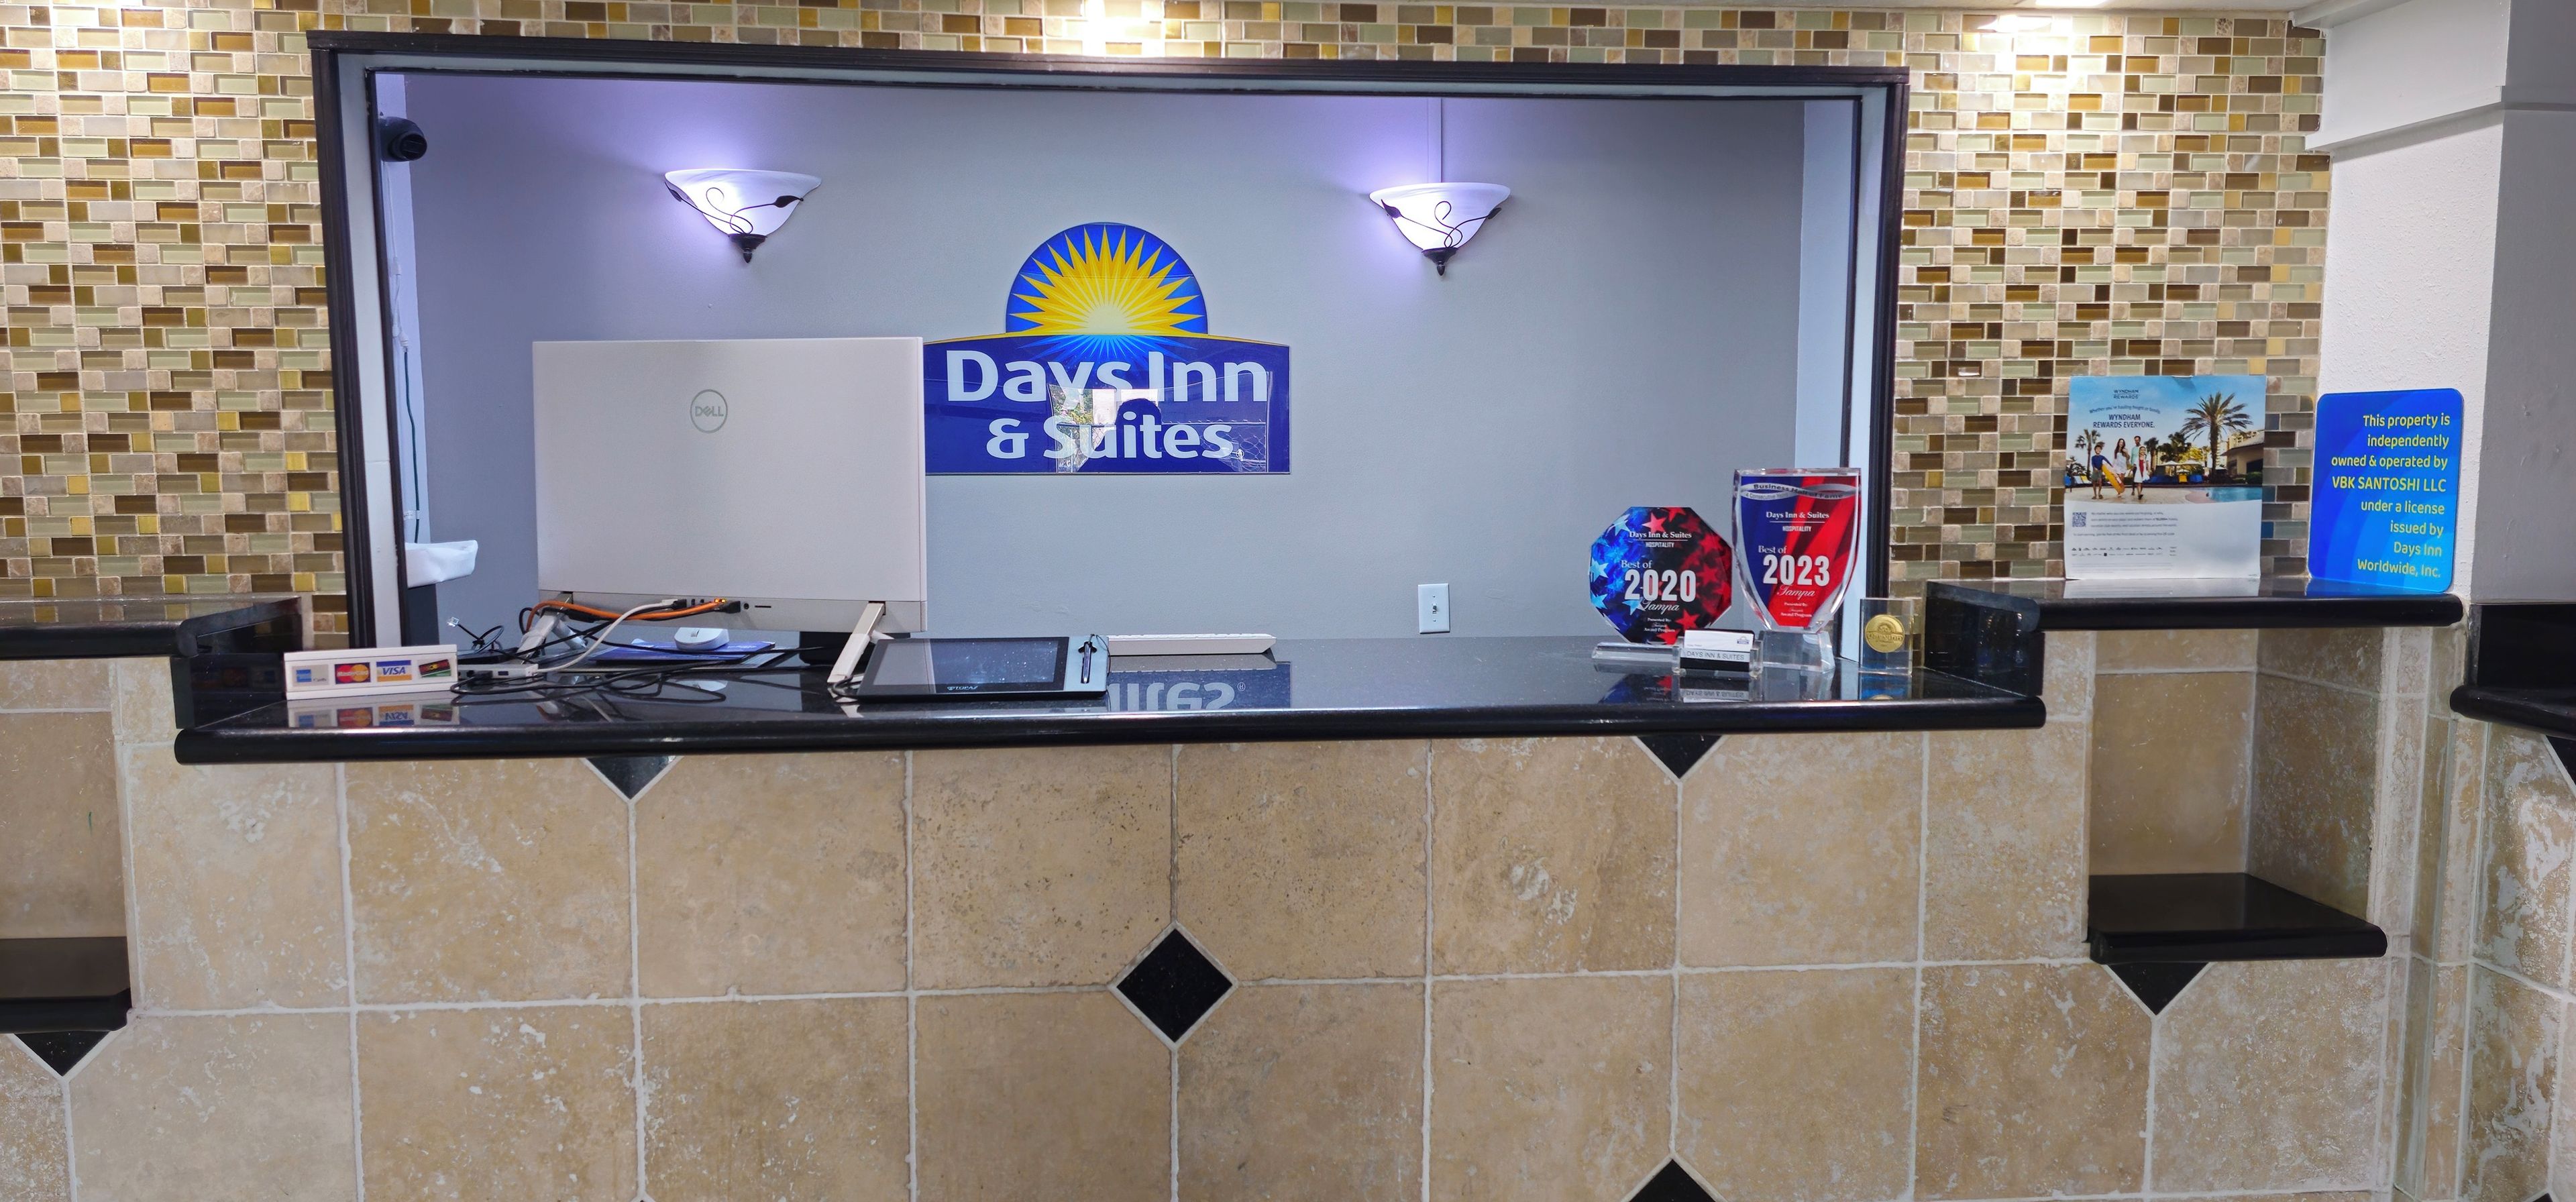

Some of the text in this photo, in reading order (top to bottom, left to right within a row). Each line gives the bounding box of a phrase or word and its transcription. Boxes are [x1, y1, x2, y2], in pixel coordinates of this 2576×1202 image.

[945, 349, 1268, 411] Days Inn
[694, 405, 724, 417] DELL
[2363, 412, 2451, 429] This property is
[985, 411, 1234, 459] & Suites
[2367, 433, 2450, 450] independently
[2331, 454, 2448, 471] owned & operated by
[1754, 484, 1790, 492] Business
[2332, 476, 2447, 492] VBK SANTOSHI LLC
[2361, 499, 2445, 515] under a license
[1766, 511, 1784, 521] Days
[1807, 511, 1830, 519] Suites
[1629, 531, 1648, 540] Days
[2390, 520, 2444, 539] issued by
[1758, 545, 1787, 554] Best of
[2393, 541, 2443, 557] Days Inn
[1621, 559, 1652, 569] Best of
[1762, 554, 1831, 587] 2023
[2357, 558, 2441, 578] Worldwide, Inc.
[1624, 569, 1697, 602] 2020
[1776, 584, 1816, 600] Tampa
[1642, 599, 1680, 615] Tampa
[382, 666, 407, 675] VISA
